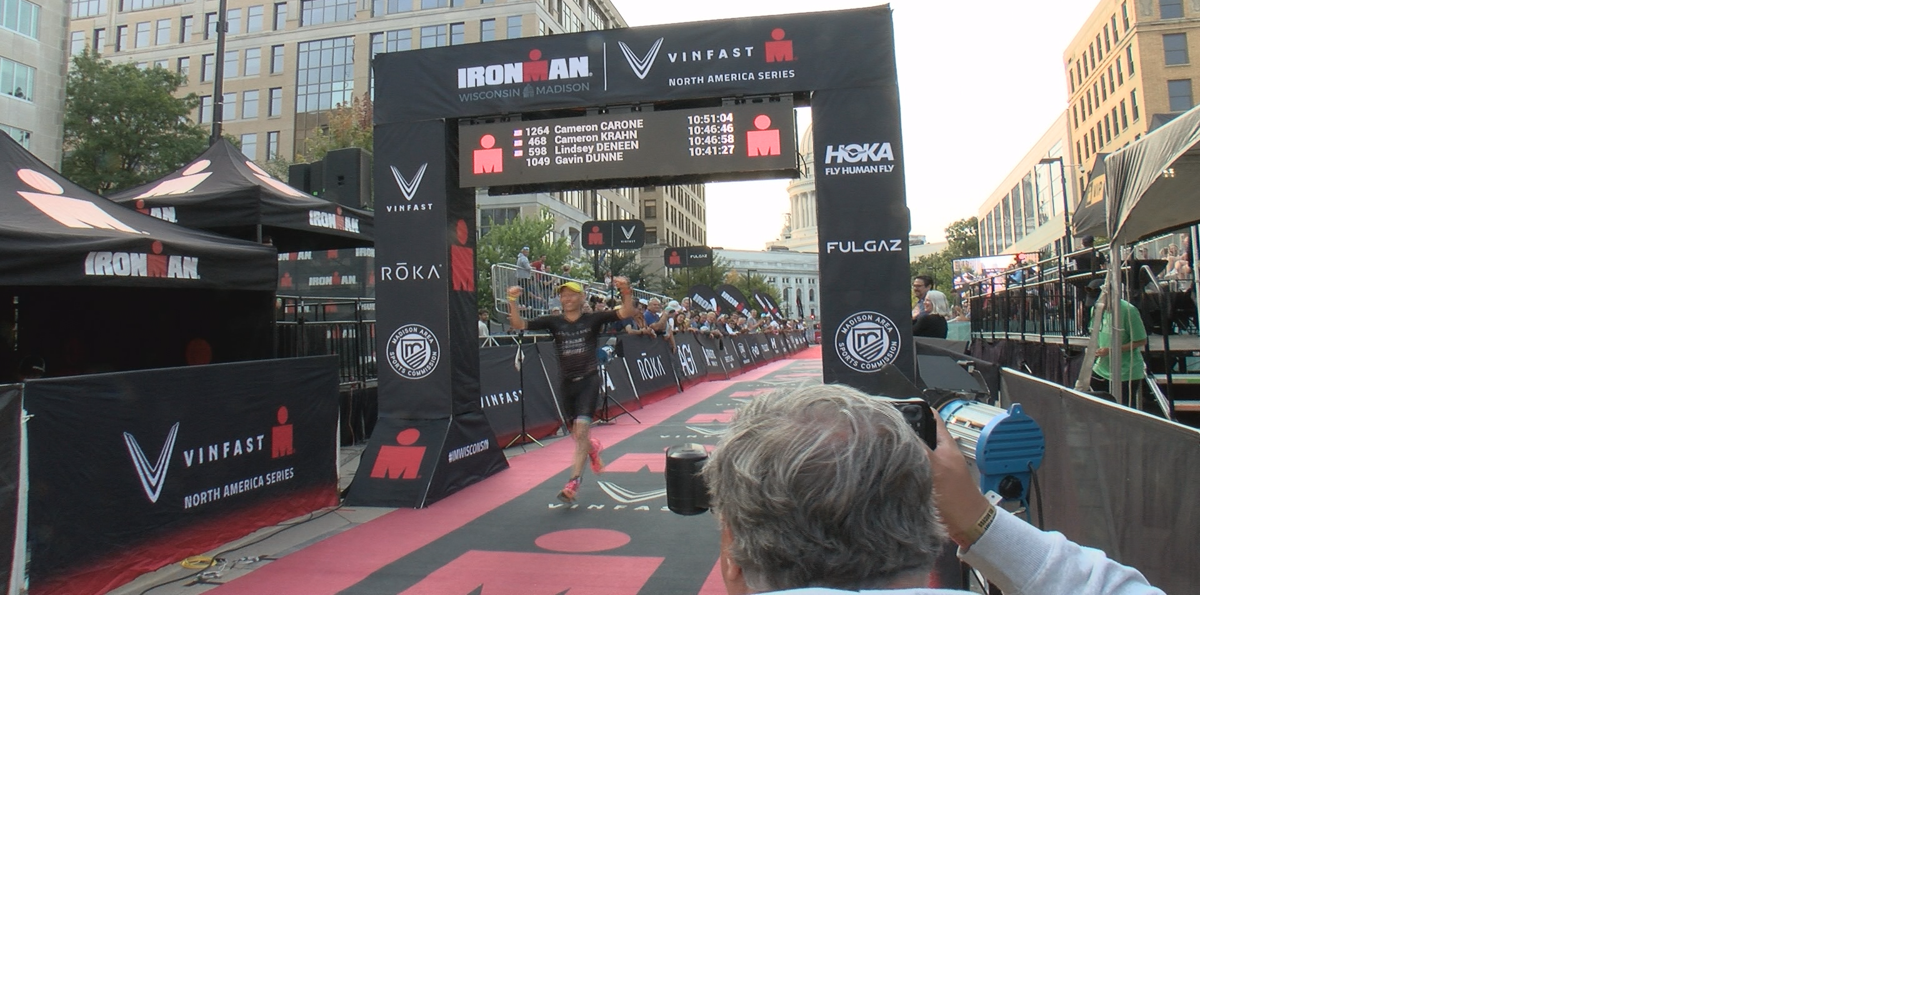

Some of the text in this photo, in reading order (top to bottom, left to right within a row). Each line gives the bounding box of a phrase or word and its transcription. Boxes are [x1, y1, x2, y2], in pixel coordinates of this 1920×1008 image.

[667, 46, 754, 63] VINFAST
[457, 49, 589, 89] IRONMAN
[668, 69, 795, 87] NORTH AMERICA SERIES
[458, 82, 590, 102] WISCONSIN MADISON
[525, 112, 734, 136] 1264 Cameron CARONE 10:51:04
[528, 123, 734, 146] 468 Cameron KRAHN 10:46:46
[526, 145, 735, 167] 1049 Gavin DUNNE 10:41:27
[528, 134, 735, 157] 598 Lindsey DENEEN 10:46:58
[824, 142, 895, 165] HOKA
[825, 164, 895, 176] FLY HUMAN FLY
[386, 203, 433, 213] VINFAST
[308, 206, 360, 234] IRONMAN
[826, 239, 903, 254] FULGAZ
[85, 240, 201, 279] IRONMAN
[308, 271, 357, 287] IRONMAN
[841, 314, 894, 334] MADISON AREA
[391, 326, 434, 345] MADISON AREA
[389, 351, 407, 374] SPORTS
[407, 351, 438, 377] COMMISSION
[838, 340, 897, 370] SPORTS COMMISSION
[183, 434, 265, 468] VINFAST
[184, 467, 294, 509] NORTH AMERICA SERIES
[548, 503, 671, 511] VINFAS
